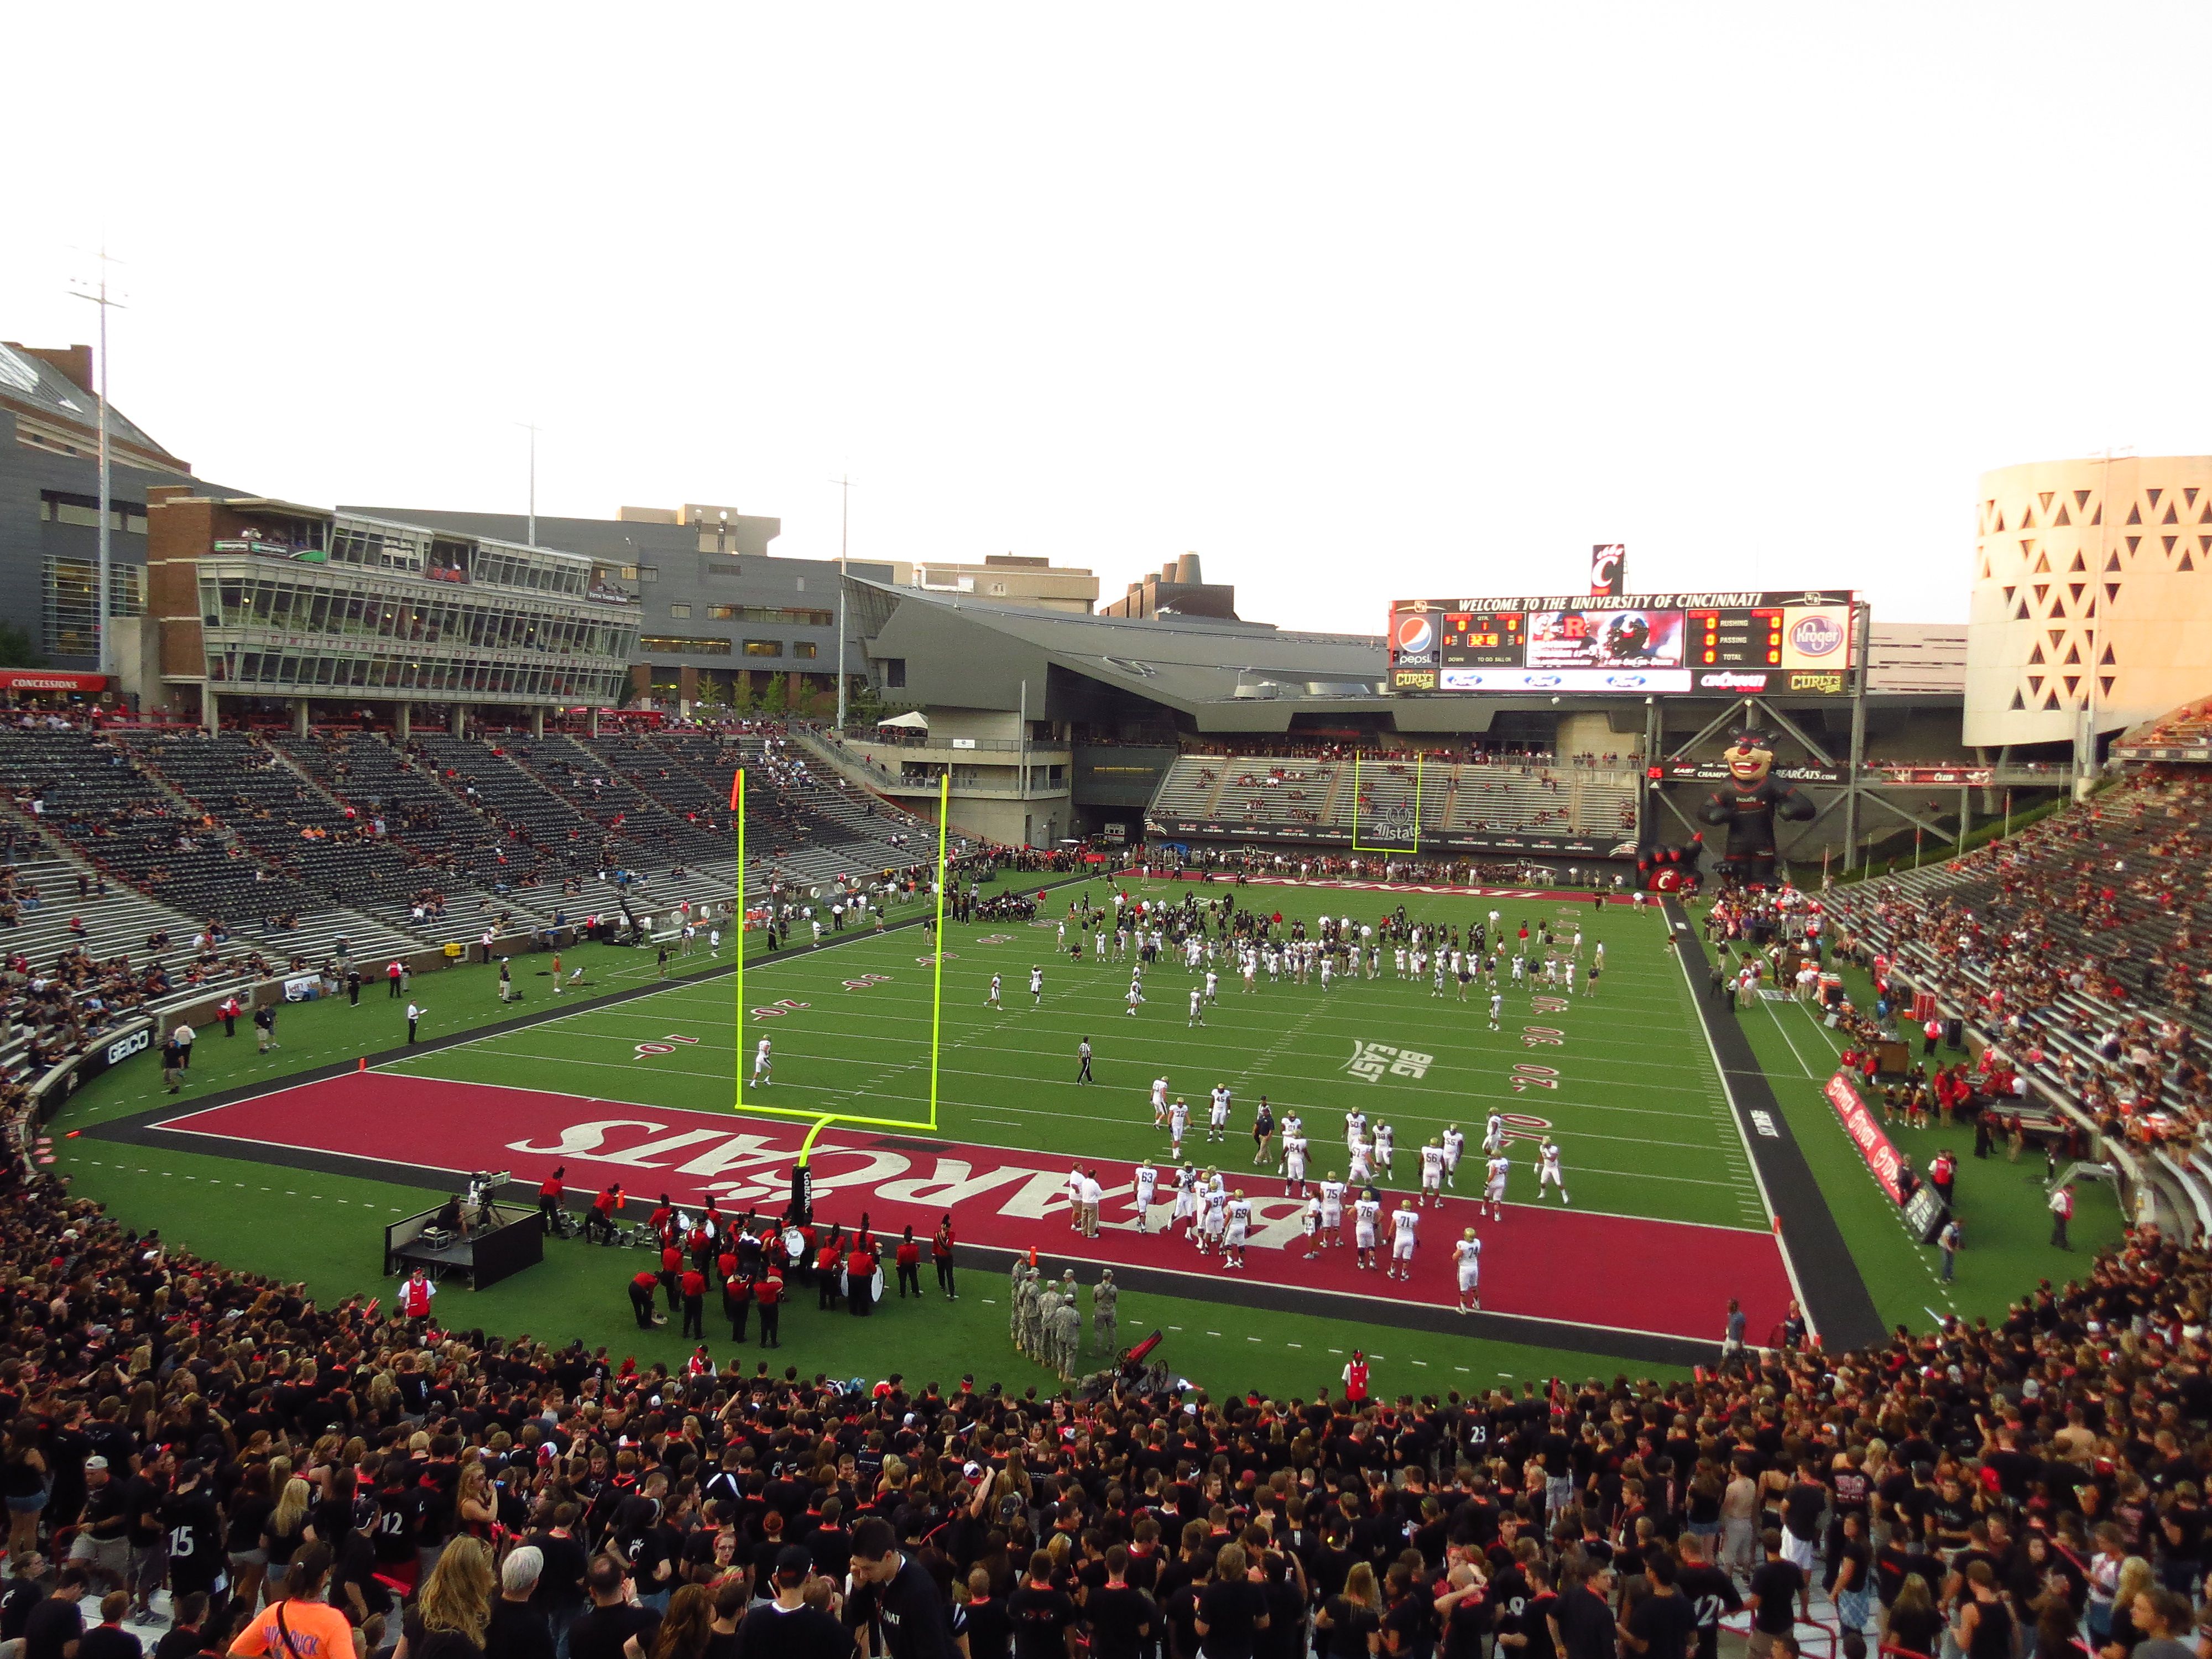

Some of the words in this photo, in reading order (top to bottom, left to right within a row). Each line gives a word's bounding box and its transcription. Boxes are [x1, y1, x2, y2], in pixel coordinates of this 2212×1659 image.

[1459, 598, 1520, 612] WELCOME
[1522, 598, 1540, 611] TO
[1542, 597, 1567, 610] THE
[1571, 594, 1652, 609] UNIVERSITY
[1655, 594, 1672, 608] OF
[1676, 593, 1763, 607] CINCINNATI
[1564, 616, 1586, 638] R
[1707, 617, 1716, 629] 0
[1771, 616, 1781, 629] 0
[1705, 633, 1715, 646] 0
[1770, 633, 1780, 645] 0
[1796, 622, 1838, 651] Kroger
[1400, 654, 1431, 665] pepsi
[1705, 650, 1715, 663] 0
[1769, 650, 1780, 663] 0
[11, 679, 77, 689] CONCESSIONS
[1396, 672, 1434, 686] CURLY'S
[1791, 675, 1841, 691] CURLY'S
[1373, 822, 1422, 840] Allstate
[108, 1030, 149, 1065] GEICO
[1347, 1043, 1398, 1082] EAST
[1390, 1050, 1434, 1079] BIG
[1835, 1084, 1856, 1114] TOYOTA
[1853, 1118, 1877, 1151] TOYOTA
[1290, 1142, 1300, 1152] 64
[1426, 1152, 1438, 1162] 56
[1141, 1171, 1153, 1183] 63
[1327, 1189, 1337, 1199] 75
[1213, 1196, 1223, 1207] 97
[1235, 1208, 1248, 1219] 69
[1361, 1206, 1373, 1217] 76
[1401, 1216, 1411, 1227] 71
[1468, 1246, 1479, 1259] 74
[1470, 1426, 1486, 1443] 23
[382, 1512, 403, 1535] 12
[169, 1525, 194, 1556] 15
